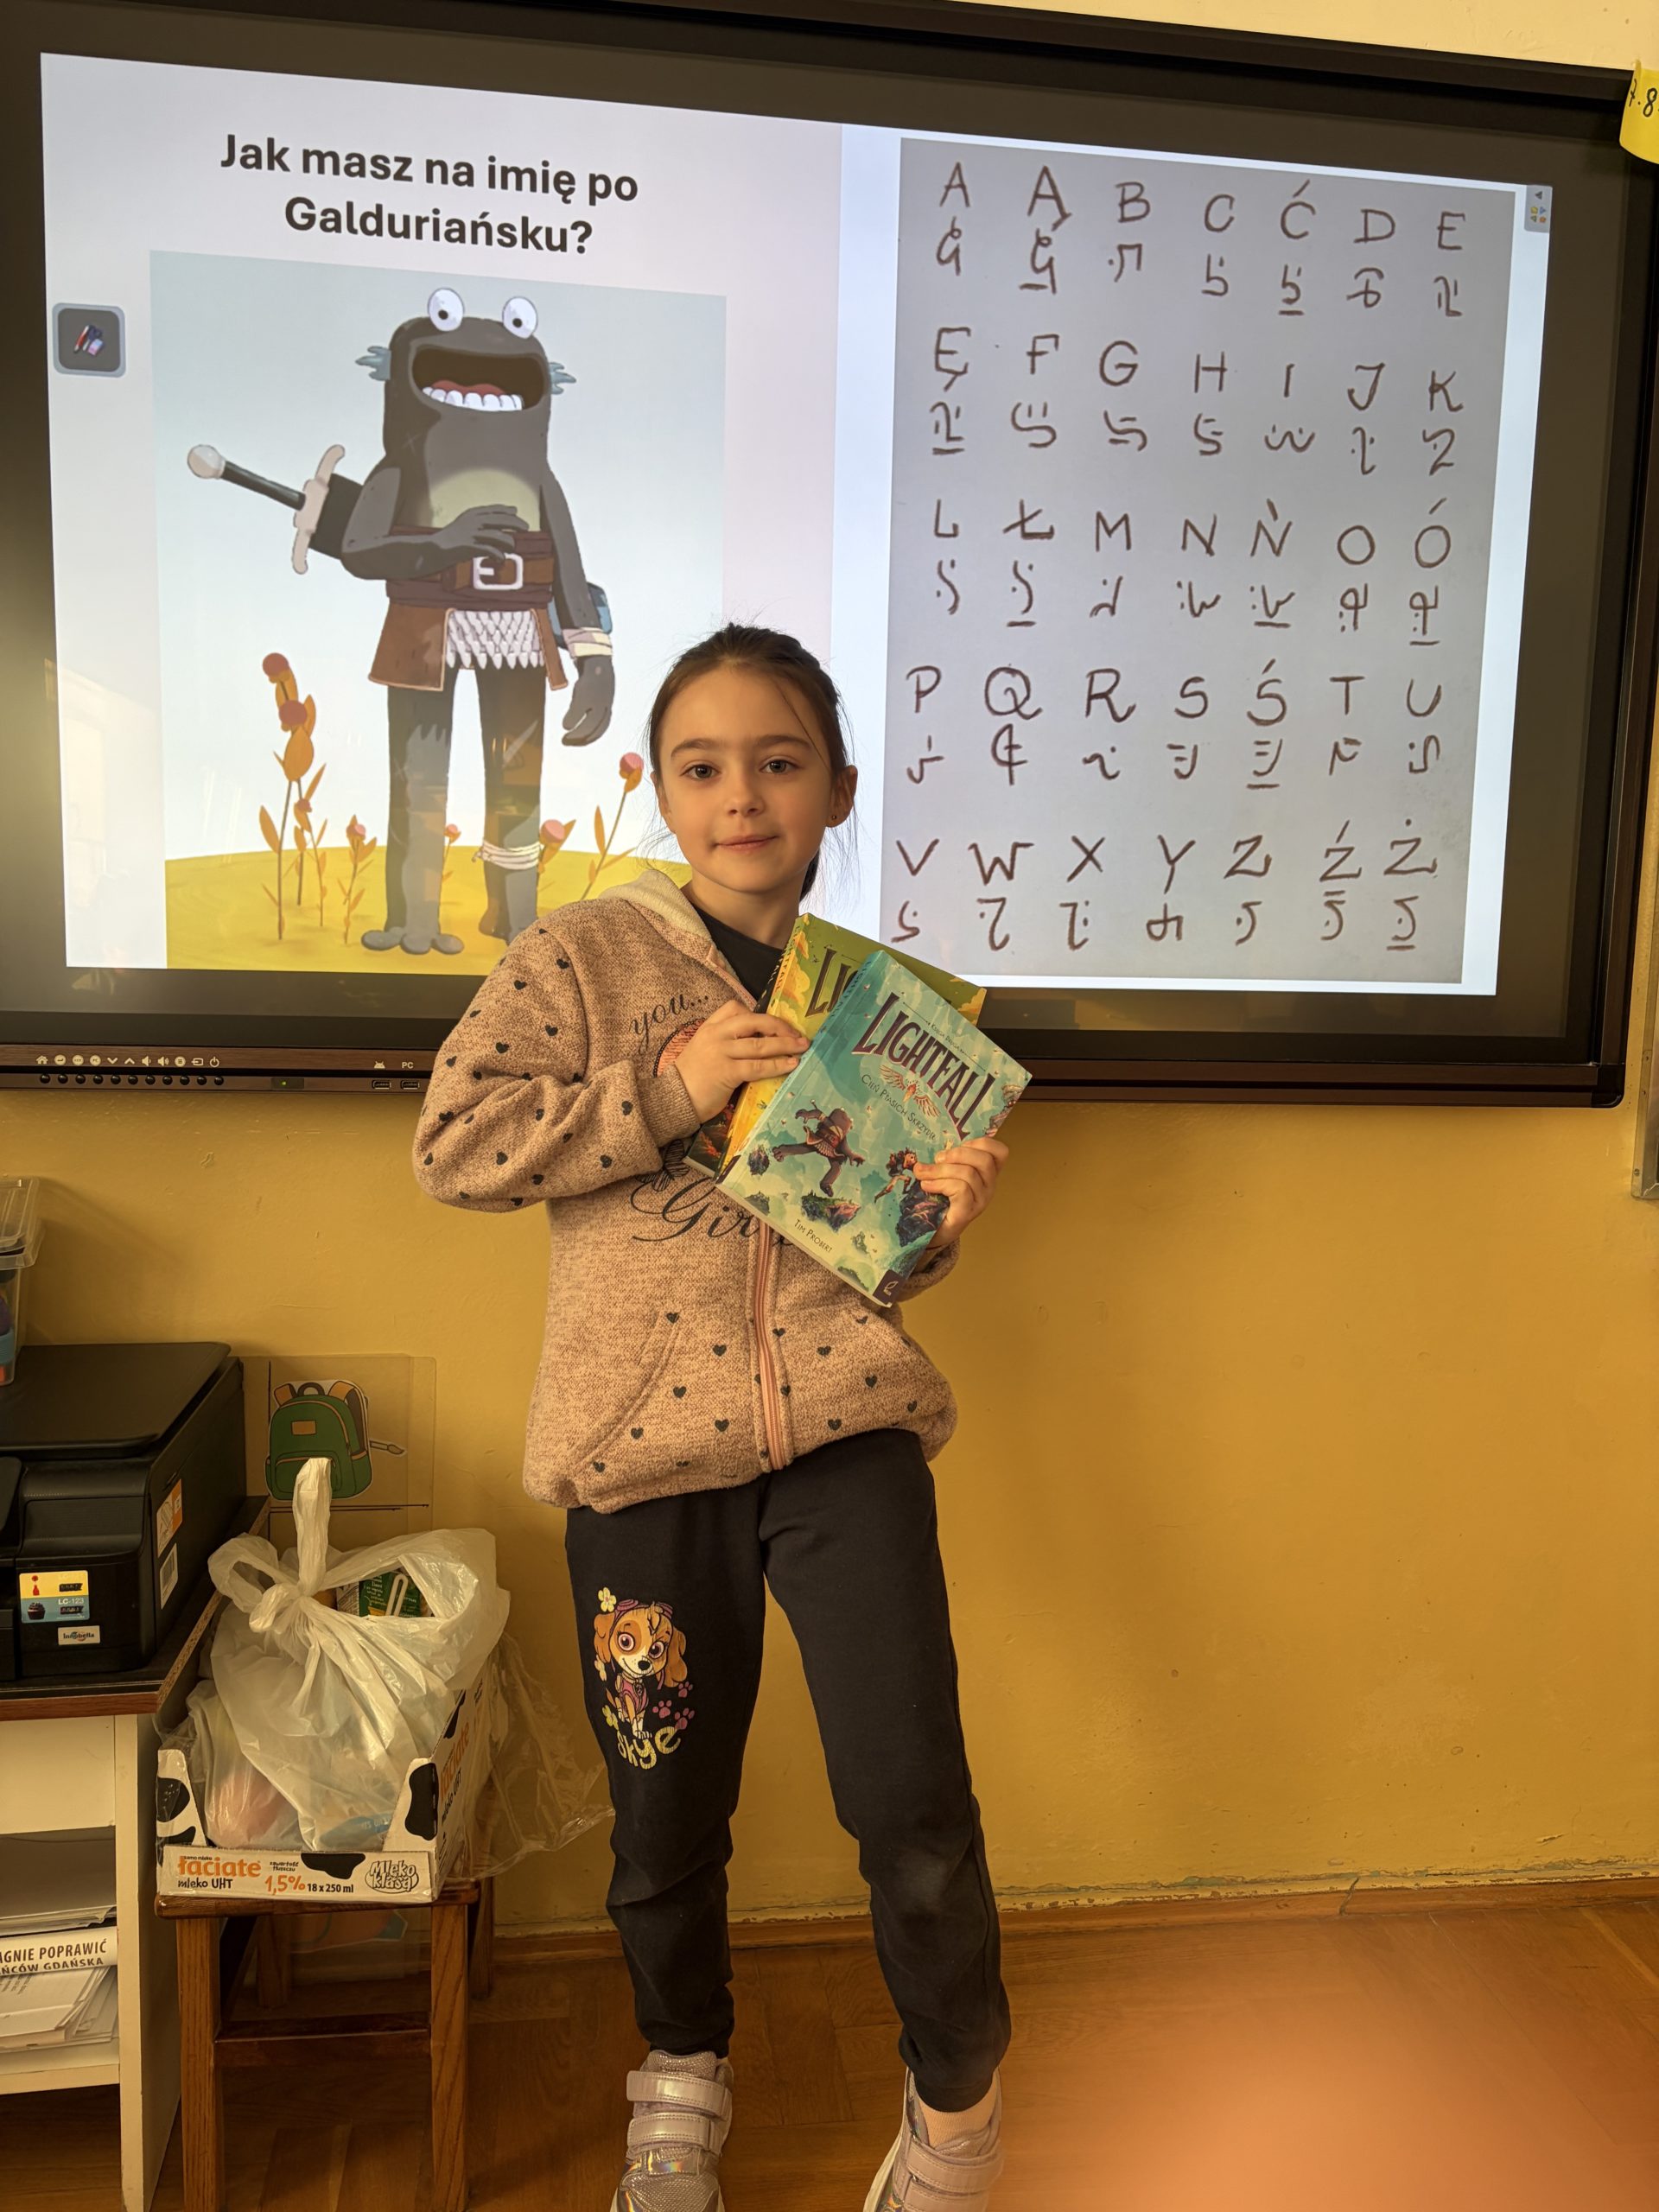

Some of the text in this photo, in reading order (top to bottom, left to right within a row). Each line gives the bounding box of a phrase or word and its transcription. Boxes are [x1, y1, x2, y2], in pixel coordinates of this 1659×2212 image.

[220, 134, 639, 206] Jak masz na imię po
[284, 196, 594, 255] Galduriańsku?
[940, 162, 1465, 251] A Ą B C Ć D E
[935, 327, 1463, 412] Ę F G H I J K
[934, 499, 959, 538] L
[1002, 499, 1054, 540] Ł
[1096, 512, 1131, 552] M
[1181, 515, 1217, 556] N
[1337, 525, 1376, 565] O
[1415, 498, 1451, 569] Ó
[906, 658, 1441, 727] P Q R S Ś T U
[896, 819, 1437, 894] V W X Y Z Ź Ż
[852, 992, 995, 1141] LIGHTFALL
[794, 1218, 833, 1253] TIM PROBERT
[178, 1855, 262, 1878] łaciate
[178, 1878, 233, 1889] mleko UHT
[264, 1874, 306, 1896] 1,5%
[326, 1884, 341, 1892] 250
[343, 1885, 353, 1893] ml
[370, 1860, 416, 1877] Mleko
[0, 1957, 104, 1975] ŃCÓW GDAŃSKA
[39, 1938, 107, 1960] POPRAWIĆ
